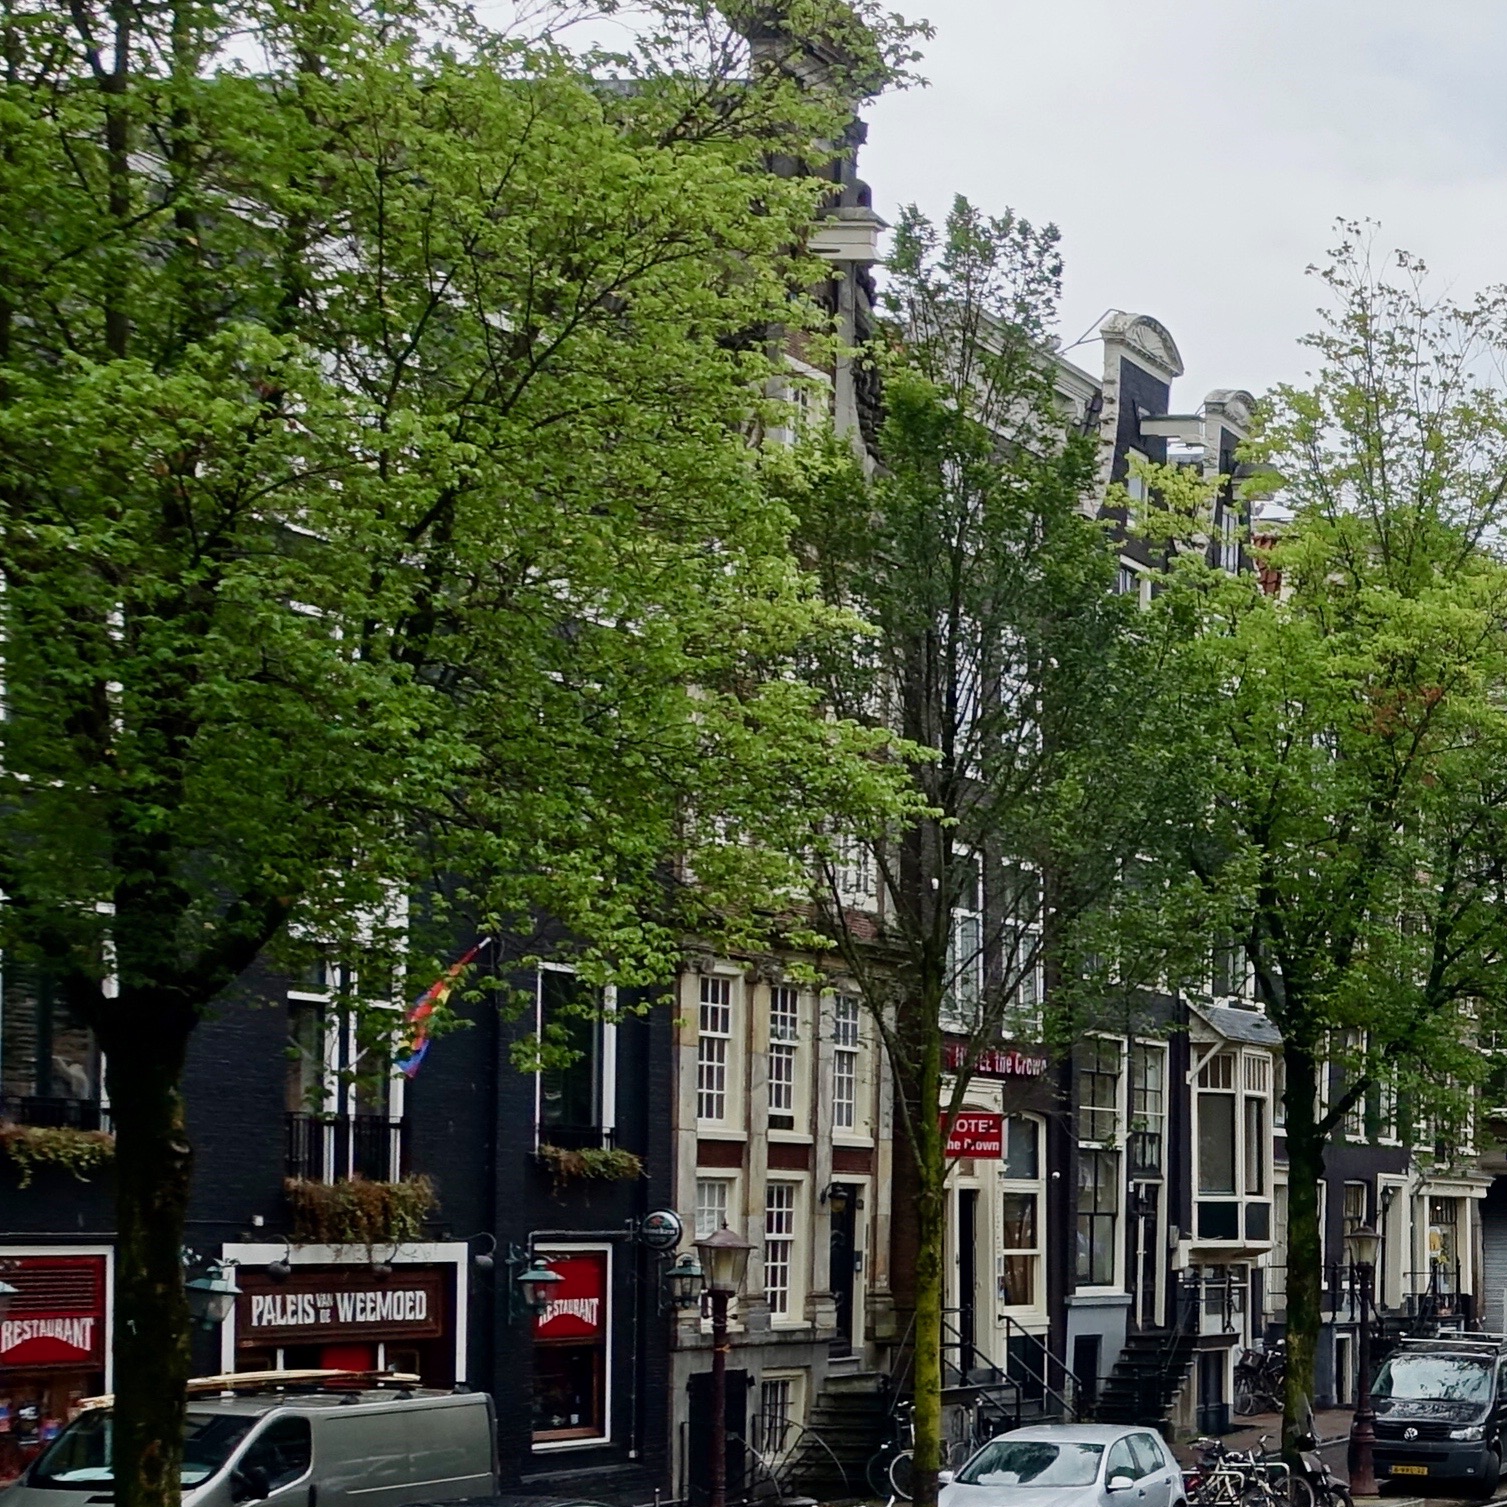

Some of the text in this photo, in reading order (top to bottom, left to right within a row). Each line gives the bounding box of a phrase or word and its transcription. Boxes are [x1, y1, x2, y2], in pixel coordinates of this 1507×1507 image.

[994, 1051, 1012, 1074] the
[955, 1119, 999, 1133] OTEL
[947, 1140, 961, 1151] he
[251, 1293, 315, 1326] PALEIS
[315, 1292, 334, 1308] VAN
[335, 1290, 427, 1323] WEEMOED
[0, 1318, 94, 1353] RESTAURANT
